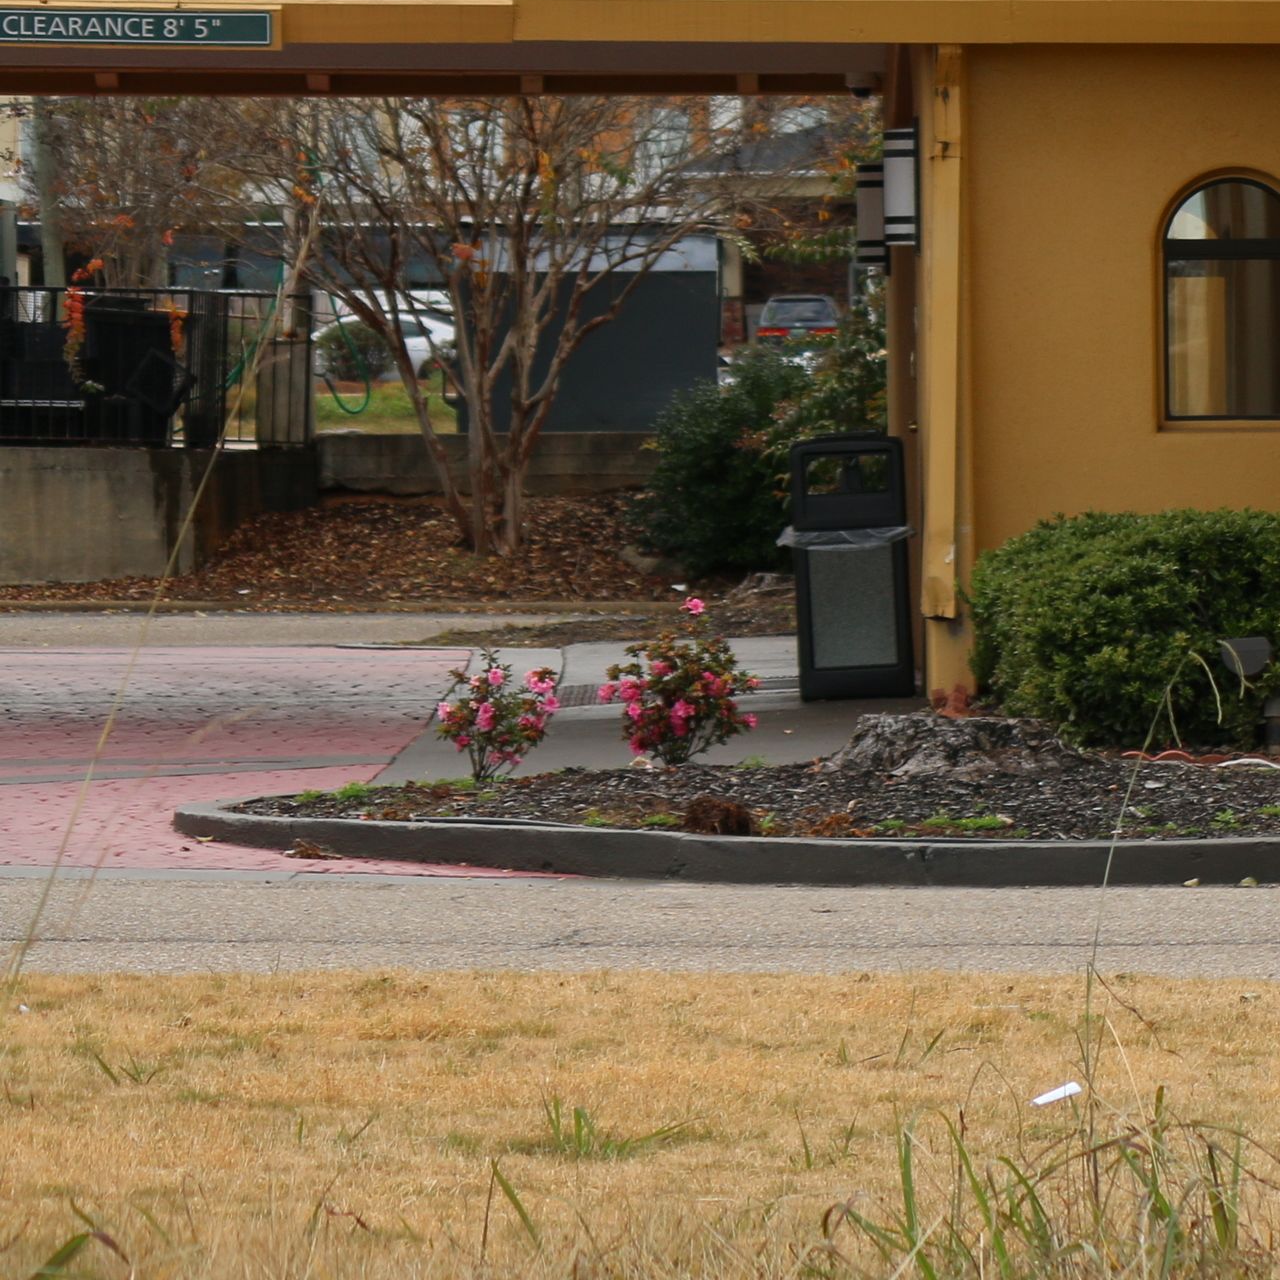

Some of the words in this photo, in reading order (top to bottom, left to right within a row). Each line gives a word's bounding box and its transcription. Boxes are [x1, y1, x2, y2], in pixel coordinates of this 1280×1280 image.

[2, 15, 155, 37] CLEARANCE
[162, 18, 185, 38] 8'
[194, 18, 222, 38] 5"
